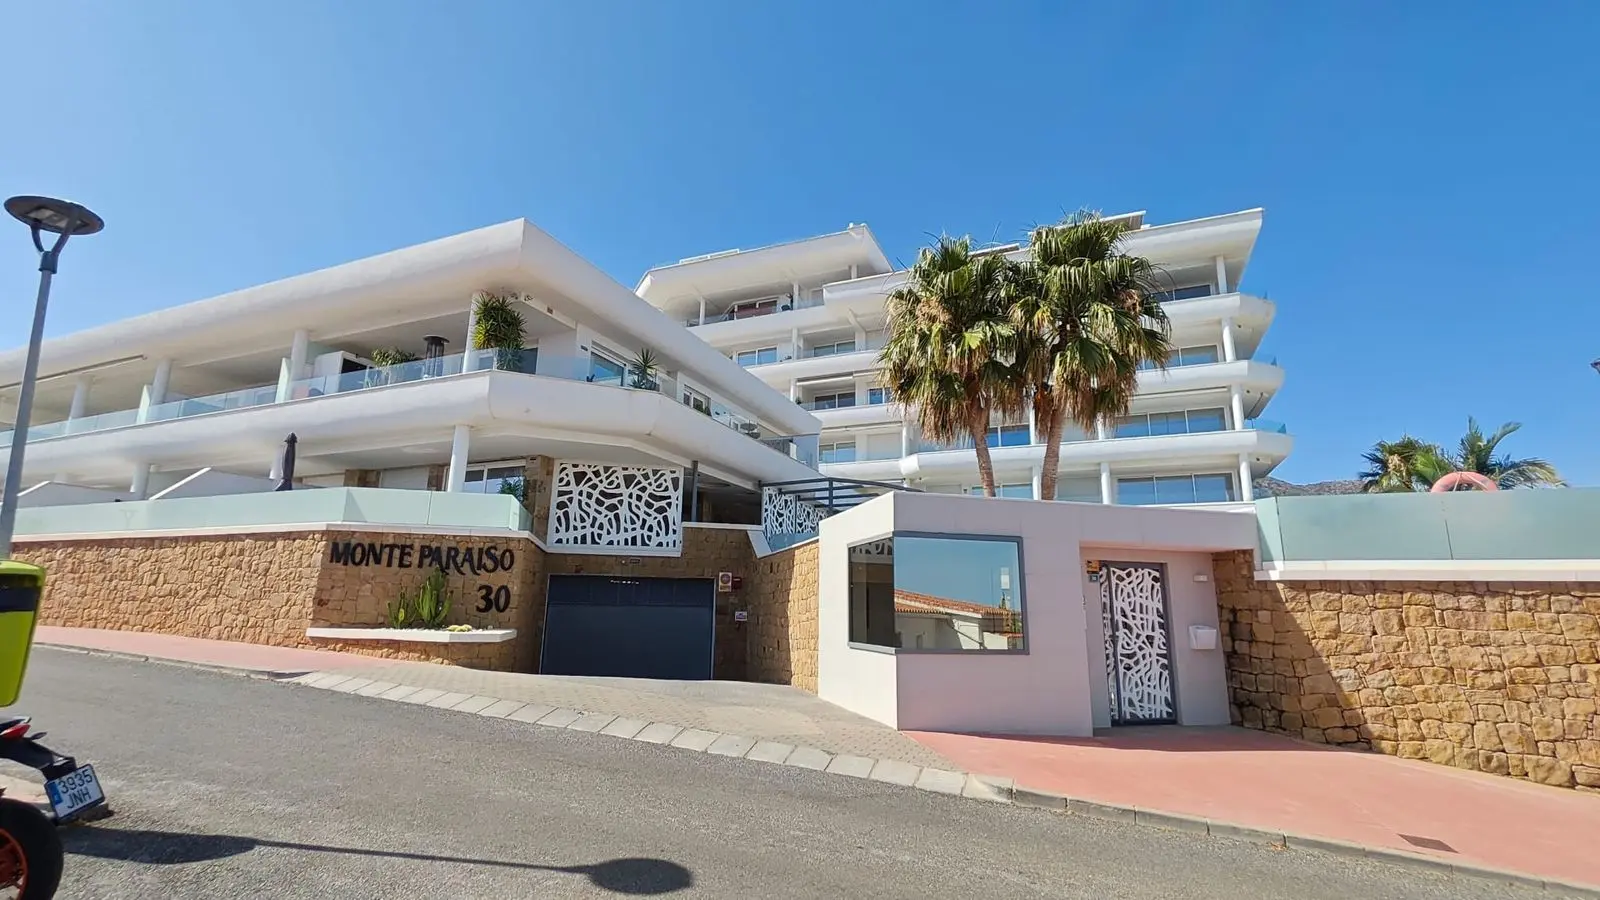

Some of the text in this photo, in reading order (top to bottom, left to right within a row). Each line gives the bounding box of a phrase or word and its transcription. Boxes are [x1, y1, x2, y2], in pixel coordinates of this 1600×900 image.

[329, 541, 515, 576] MONTE PARAISO
[475, 584, 511, 613] 30
[59, 769, 93, 794] 3935
[67, 787, 92, 809] JNH
